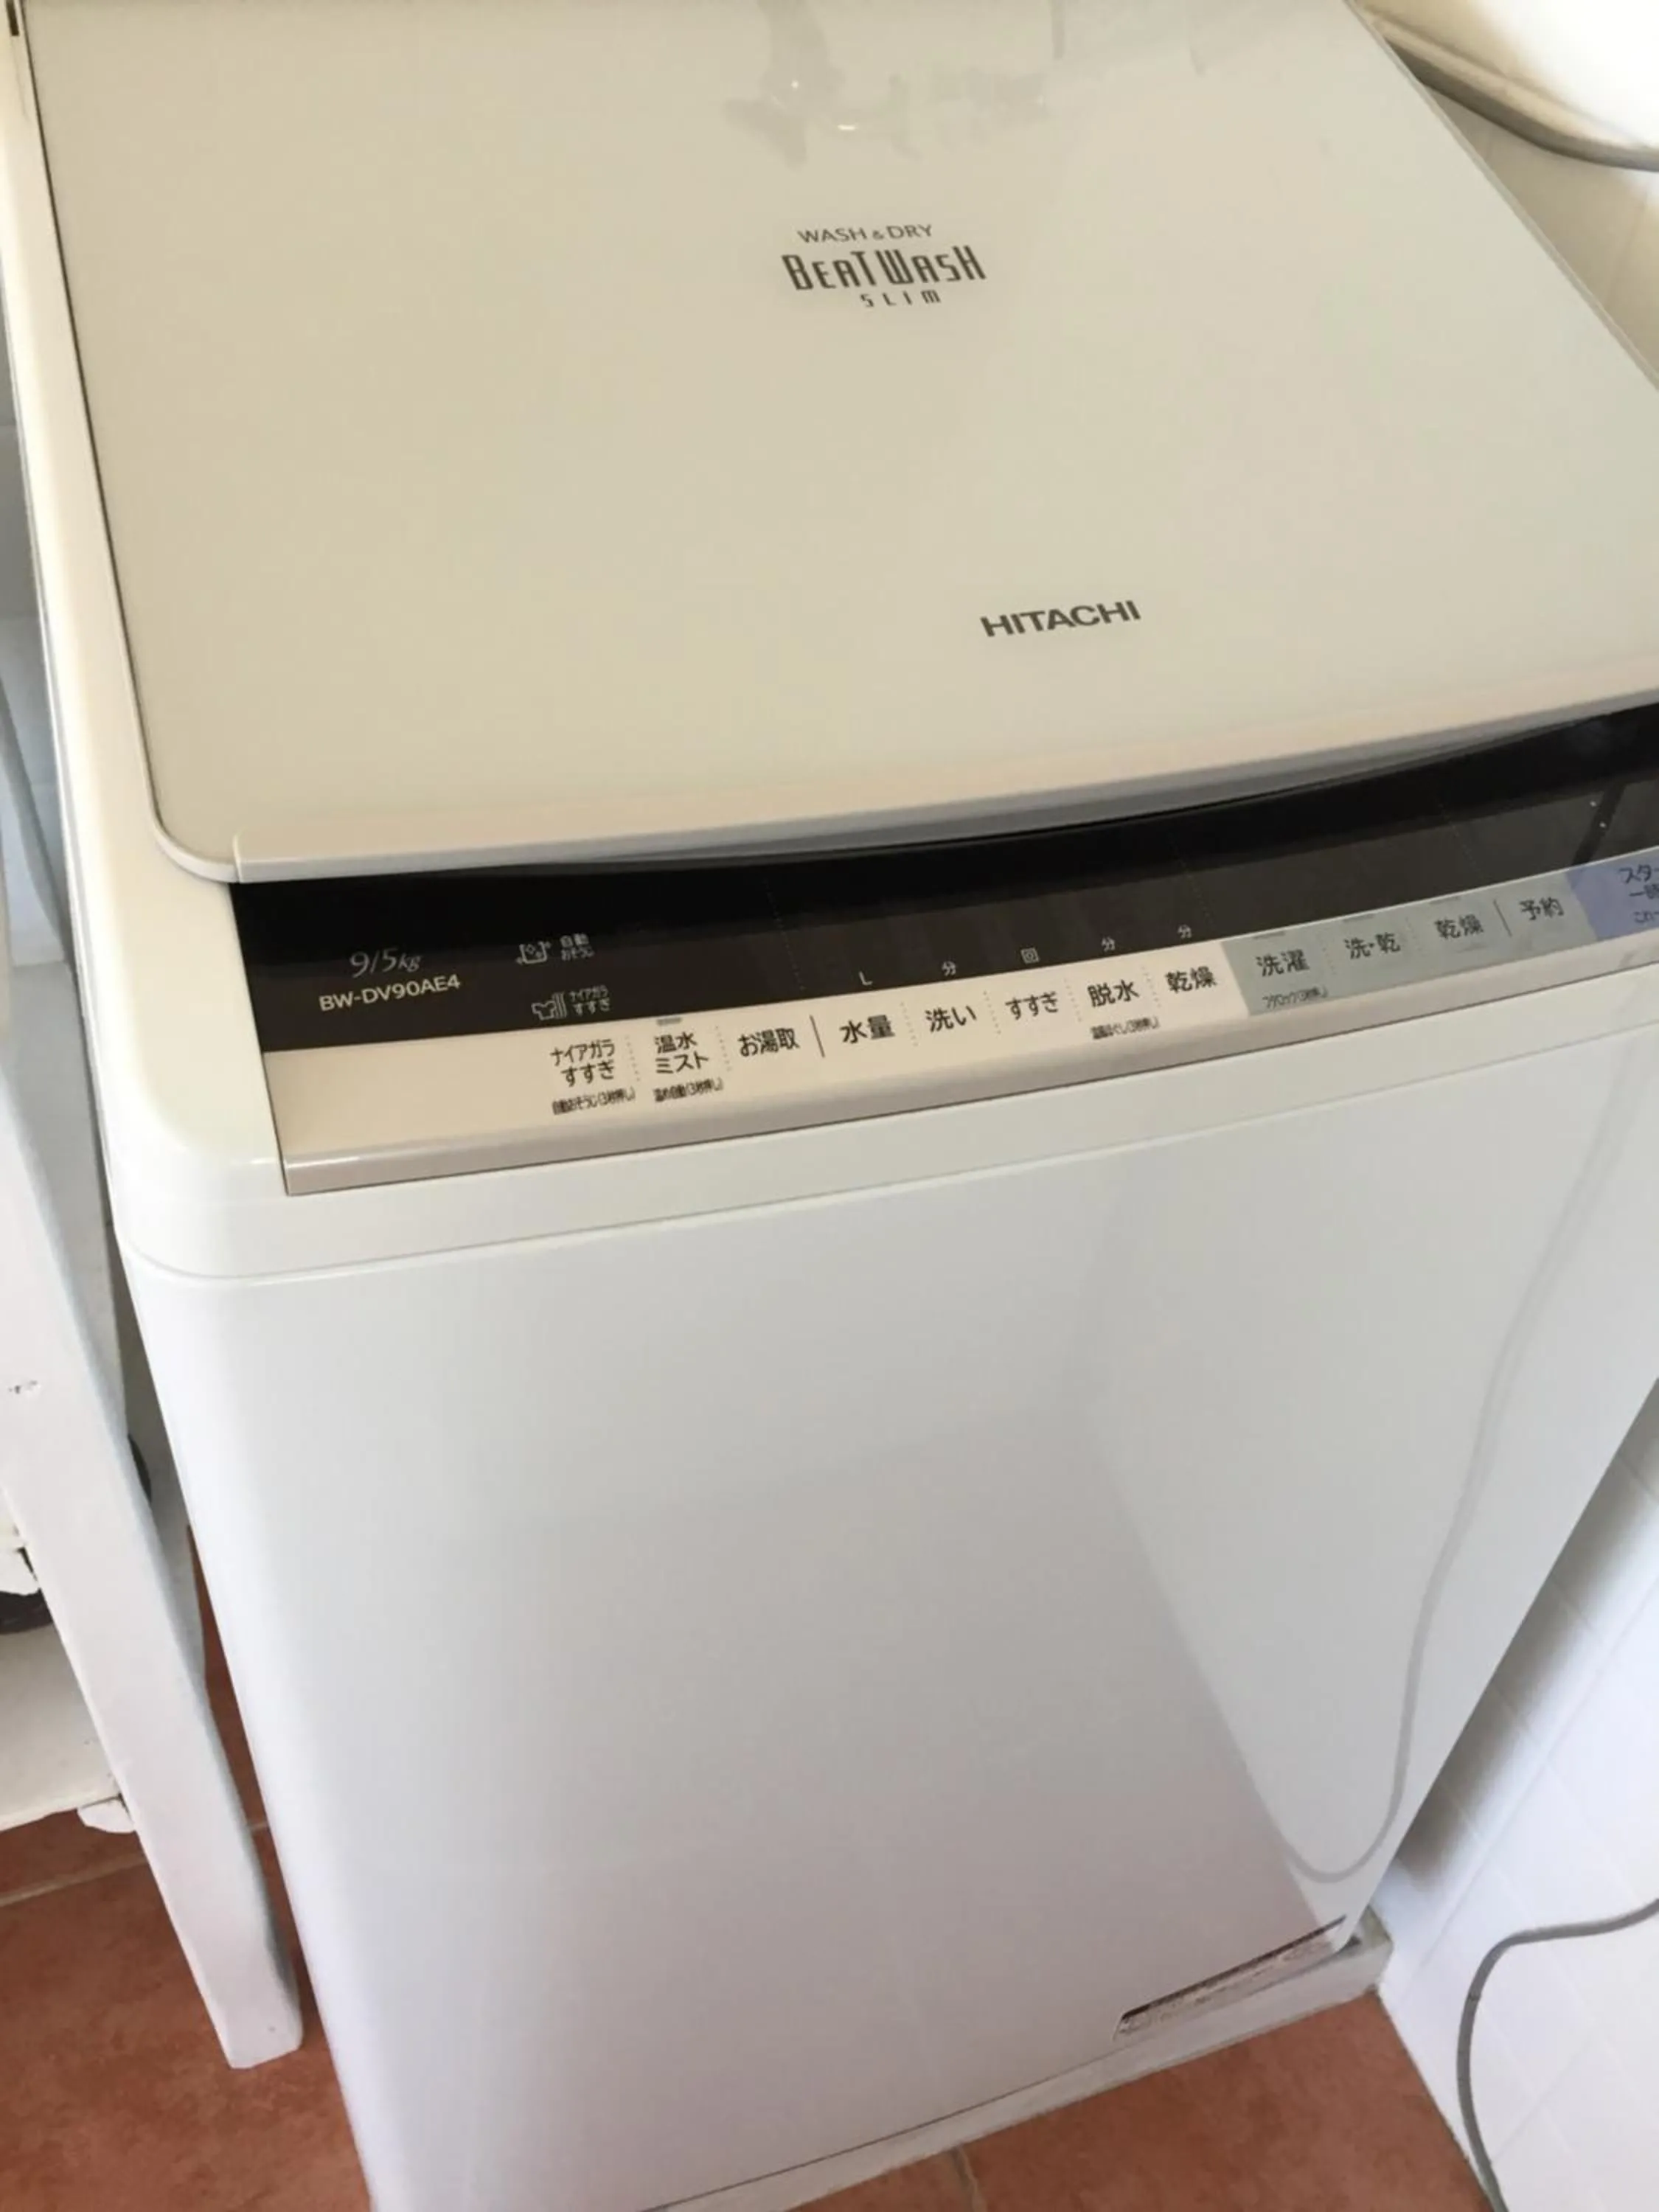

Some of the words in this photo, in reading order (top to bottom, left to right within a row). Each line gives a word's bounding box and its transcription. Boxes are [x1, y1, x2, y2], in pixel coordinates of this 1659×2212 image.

[797, 226, 868, 243] WASH
[872, 230, 884, 240] &
[886, 224, 932, 240] DRY
[980, 599, 1141, 637] HITACHI
[1519, 896, 1565, 922] 予約
[1178, 923, 1192, 939] 分
[1433, 914, 1484, 939] 乾燥
[1020, 947, 1040, 964] 回
[1102, 936, 1116, 952] 分
[942, 961, 956, 975] 分
[1256, 948, 1310, 978] 洗濯
[319, 973, 461, 1011] BW-DV90AE4
[1165, 965, 1217, 994] 乾燥
[1005, 991, 1059, 1020] すすぎ
[1087, 979, 1140, 1009] 脱水
[839, 1014, 895, 1044] 水量
[925, 1005, 977, 1033] 洗い
[551, 1038, 615, 1066] ナイアガラ
[654, 1032, 698, 1054] 温水
[737, 1027, 800, 1057] お湯取
[560, 1059, 614, 1088] すすぎ
[655, 1051, 709, 1074] ミスト
